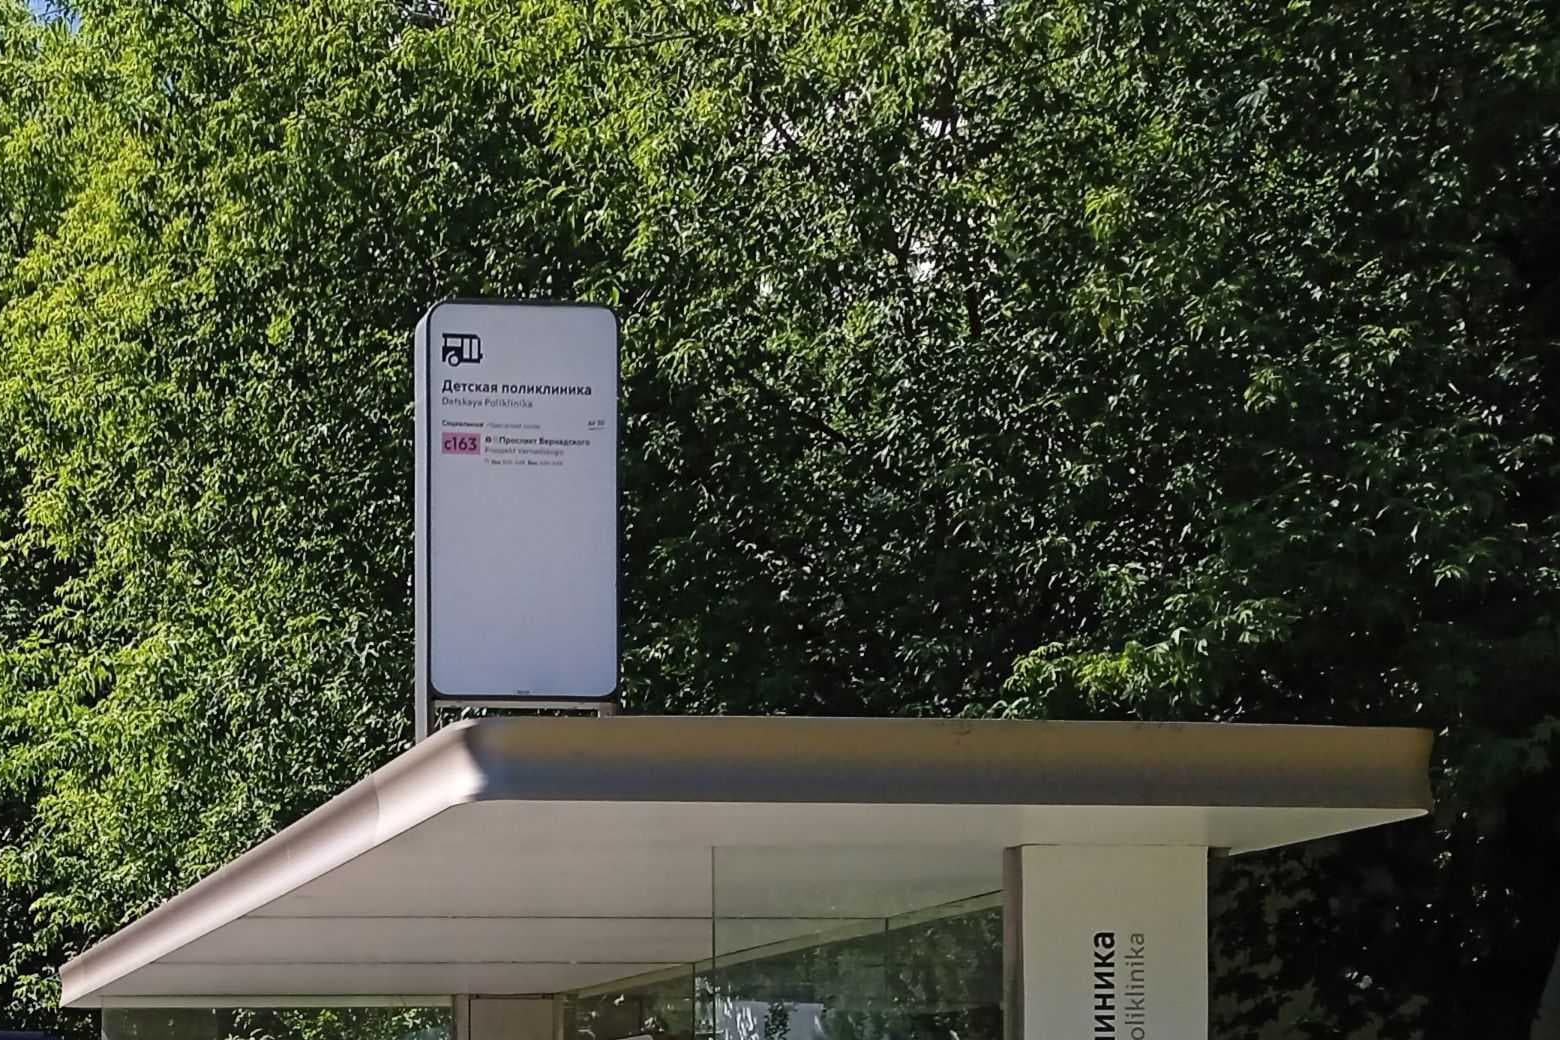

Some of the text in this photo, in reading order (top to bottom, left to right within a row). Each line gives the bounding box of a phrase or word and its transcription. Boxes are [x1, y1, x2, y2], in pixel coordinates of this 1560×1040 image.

[441, 379, 592, 396] Детская поликлиника
[443, 436, 478, 451] с163
